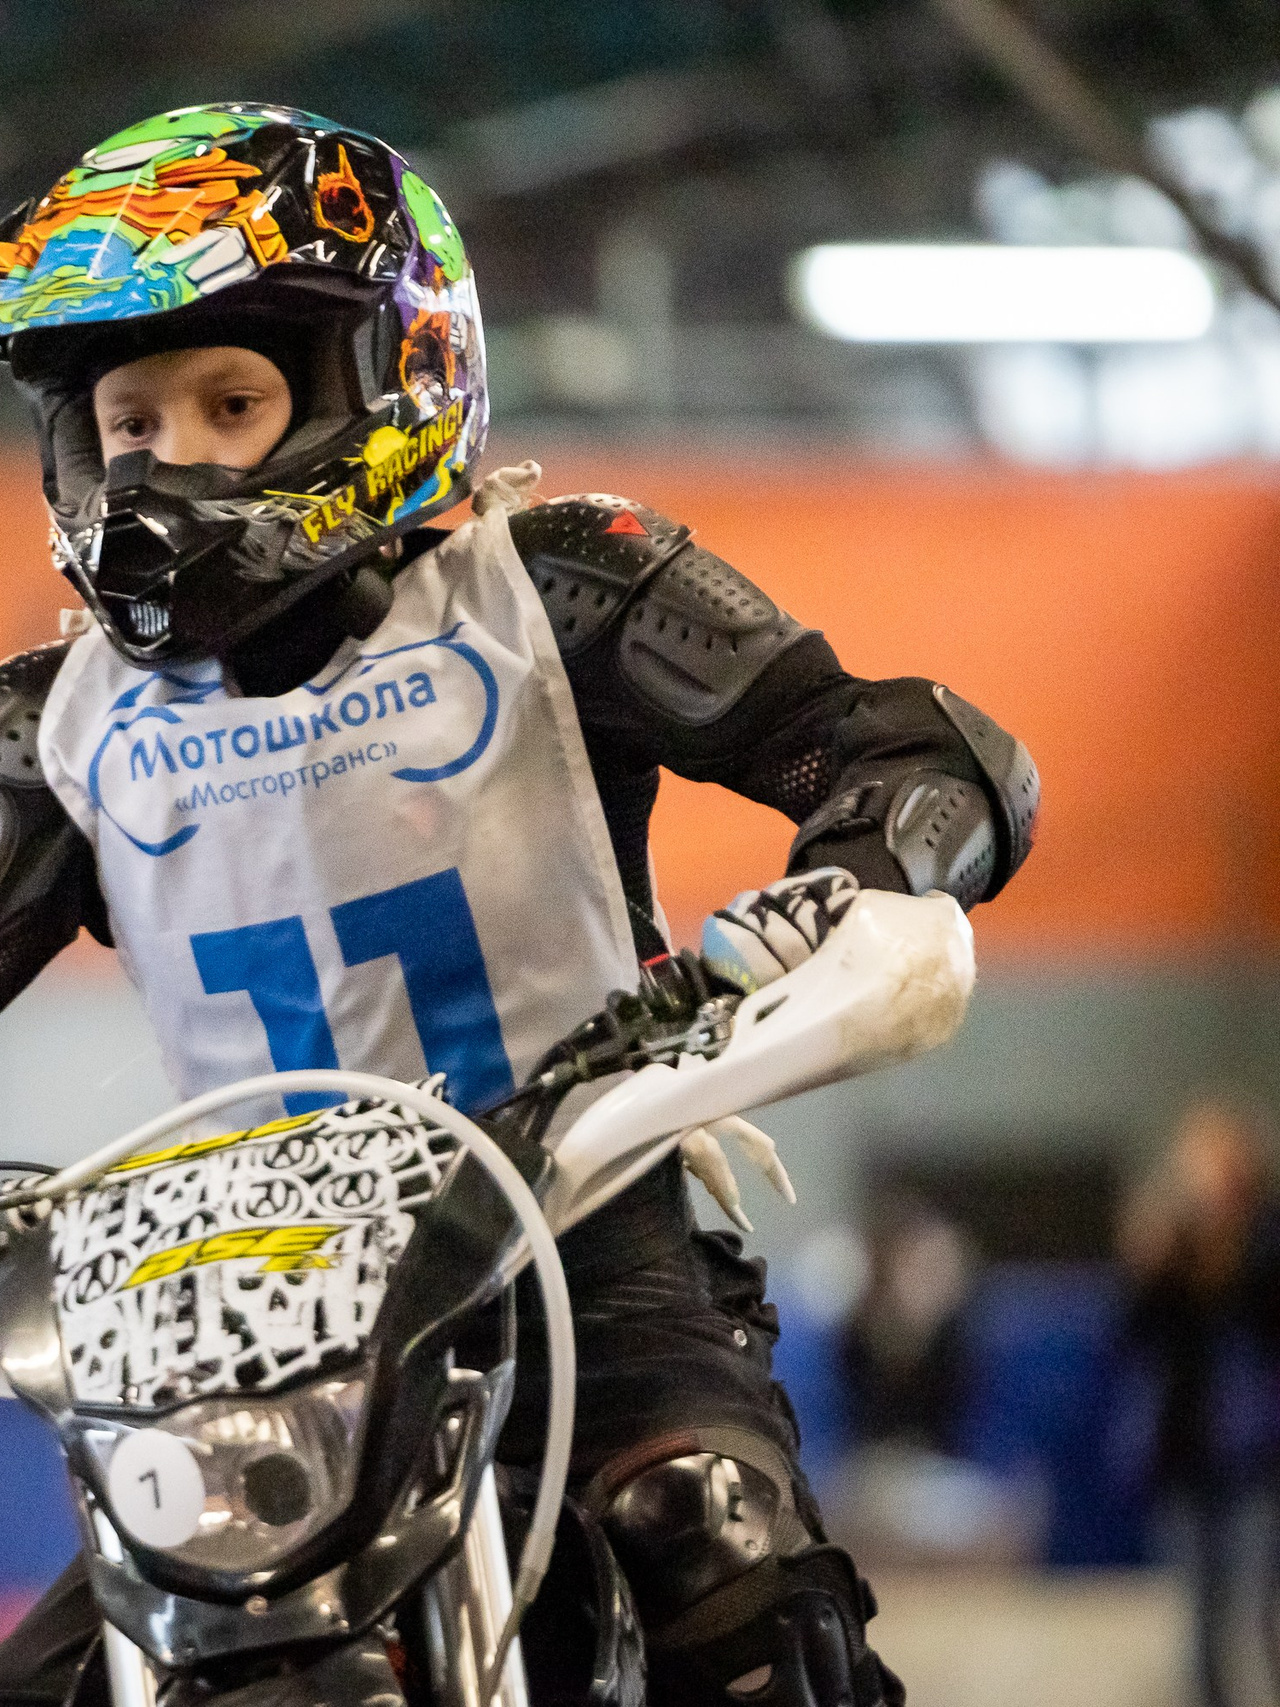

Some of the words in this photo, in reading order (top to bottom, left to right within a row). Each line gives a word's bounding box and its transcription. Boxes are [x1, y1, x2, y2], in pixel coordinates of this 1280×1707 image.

[302, 485, 356, 543] FLY
[366, 401, 463, 498] RACING!
[129, 671, 437, 781] Мотошкола
[175, 741, 398, 813] «Мосгортранс»
[189, 866, 516, 1117] 11
